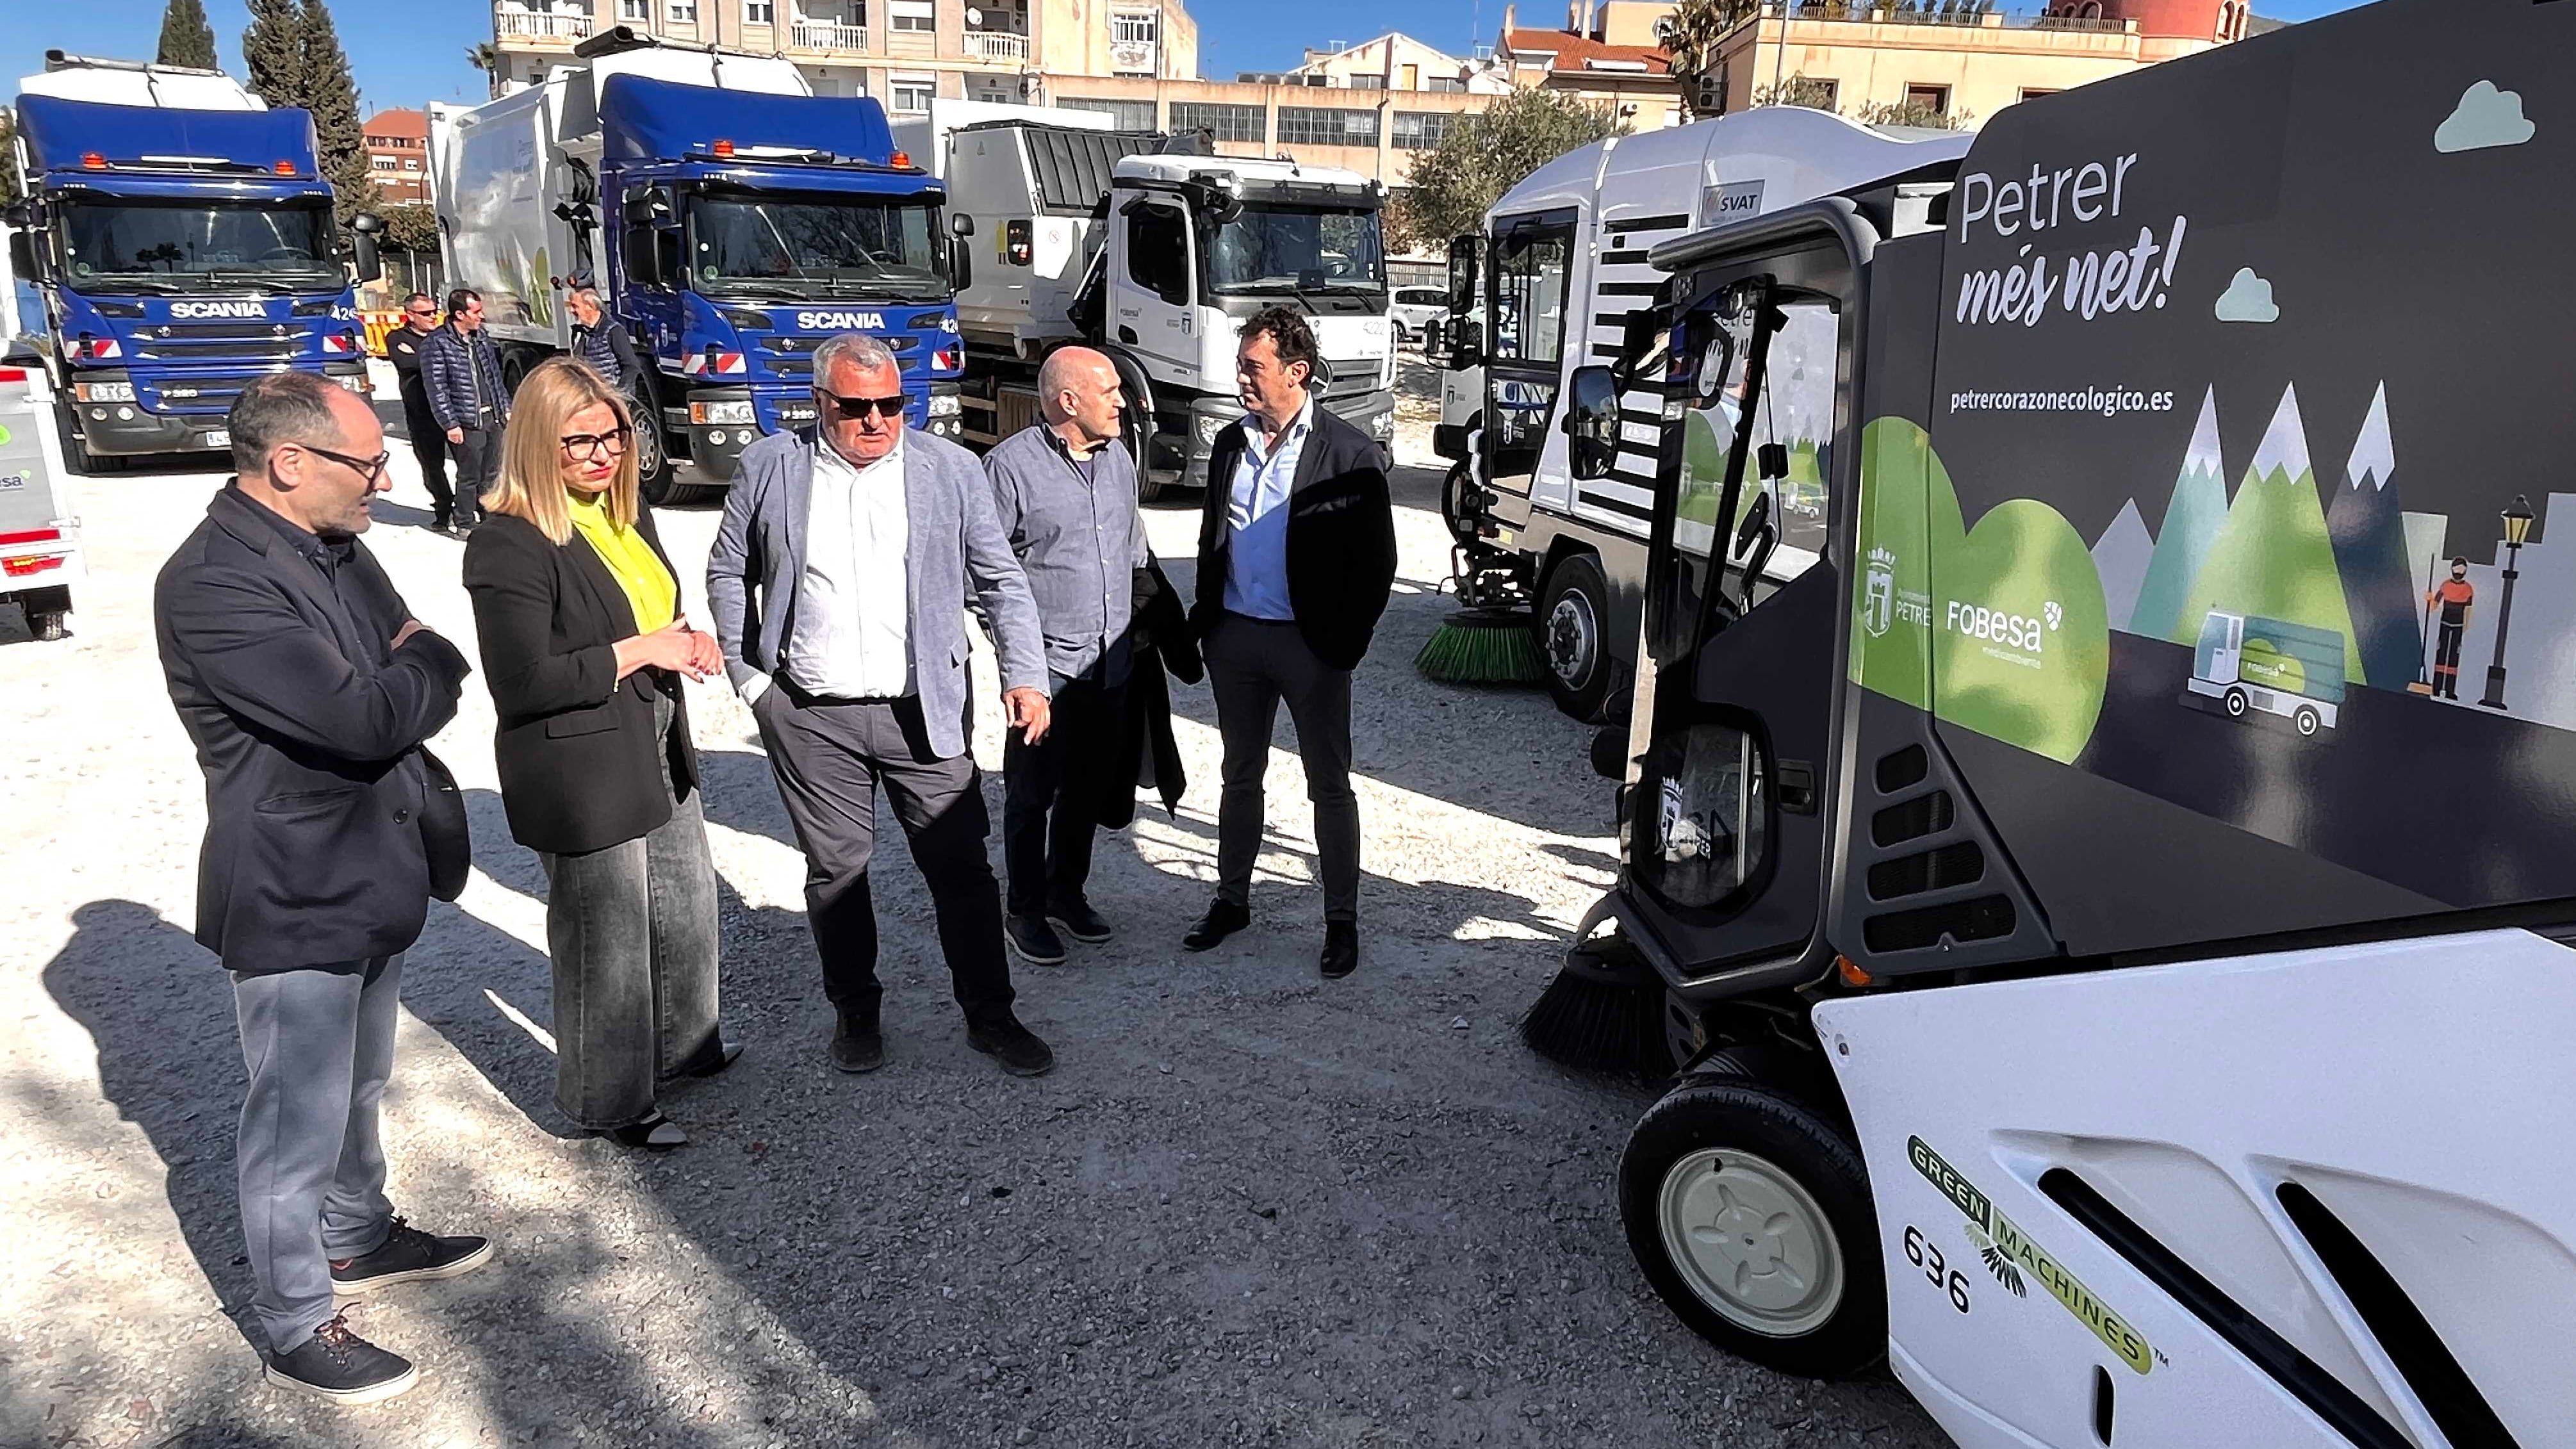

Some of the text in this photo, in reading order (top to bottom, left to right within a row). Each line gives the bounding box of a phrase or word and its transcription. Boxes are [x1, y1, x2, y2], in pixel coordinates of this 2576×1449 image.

[1720, 194, 1758, 212] SVAT
[1962, 152, 2138, 243] Petrer
[1957, 215, 2187, 327] més net!
[170, 302, 267, 318] SCANIA
[797, 312, 885, 329] SCANIA
[1950, 385, 2174, 416] petrercorazonecologico.es
[1904, 1225, 1971, 1314] 636
[1914, 1146, 1984, 1222] GREEN
[1999, 1220, 2139, 1361] MACHINES
